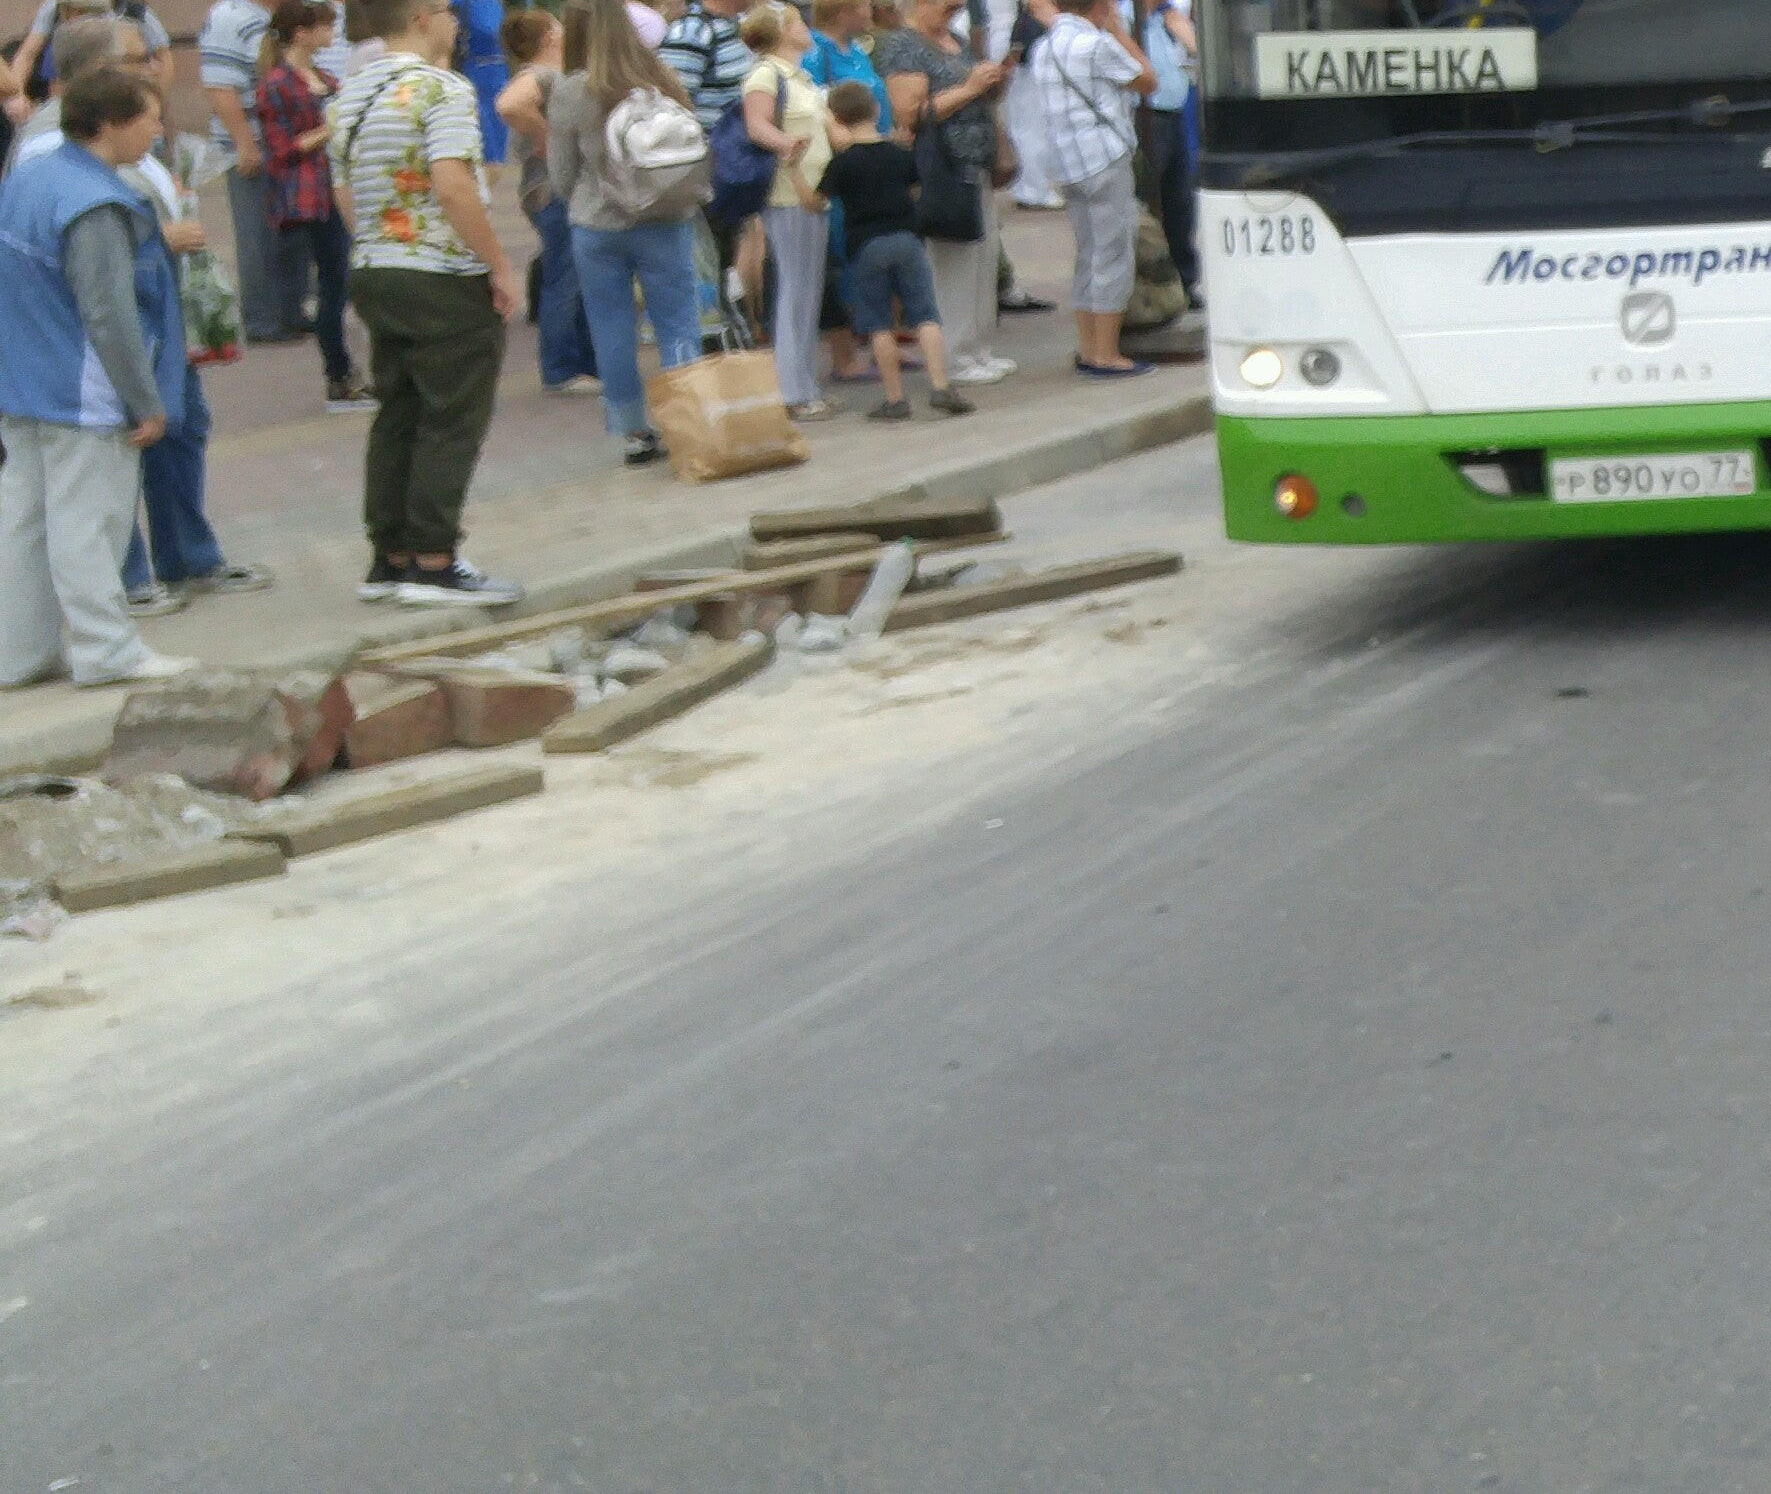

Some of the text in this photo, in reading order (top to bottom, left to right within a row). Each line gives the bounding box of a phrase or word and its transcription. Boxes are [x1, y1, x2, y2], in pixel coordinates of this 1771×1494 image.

[1285, 45, 1506, 94] КАМЕНКА
[1222, 214, 1318, 258] 01288
[1590, 363, 1717, 383] ГОЛАЗ
